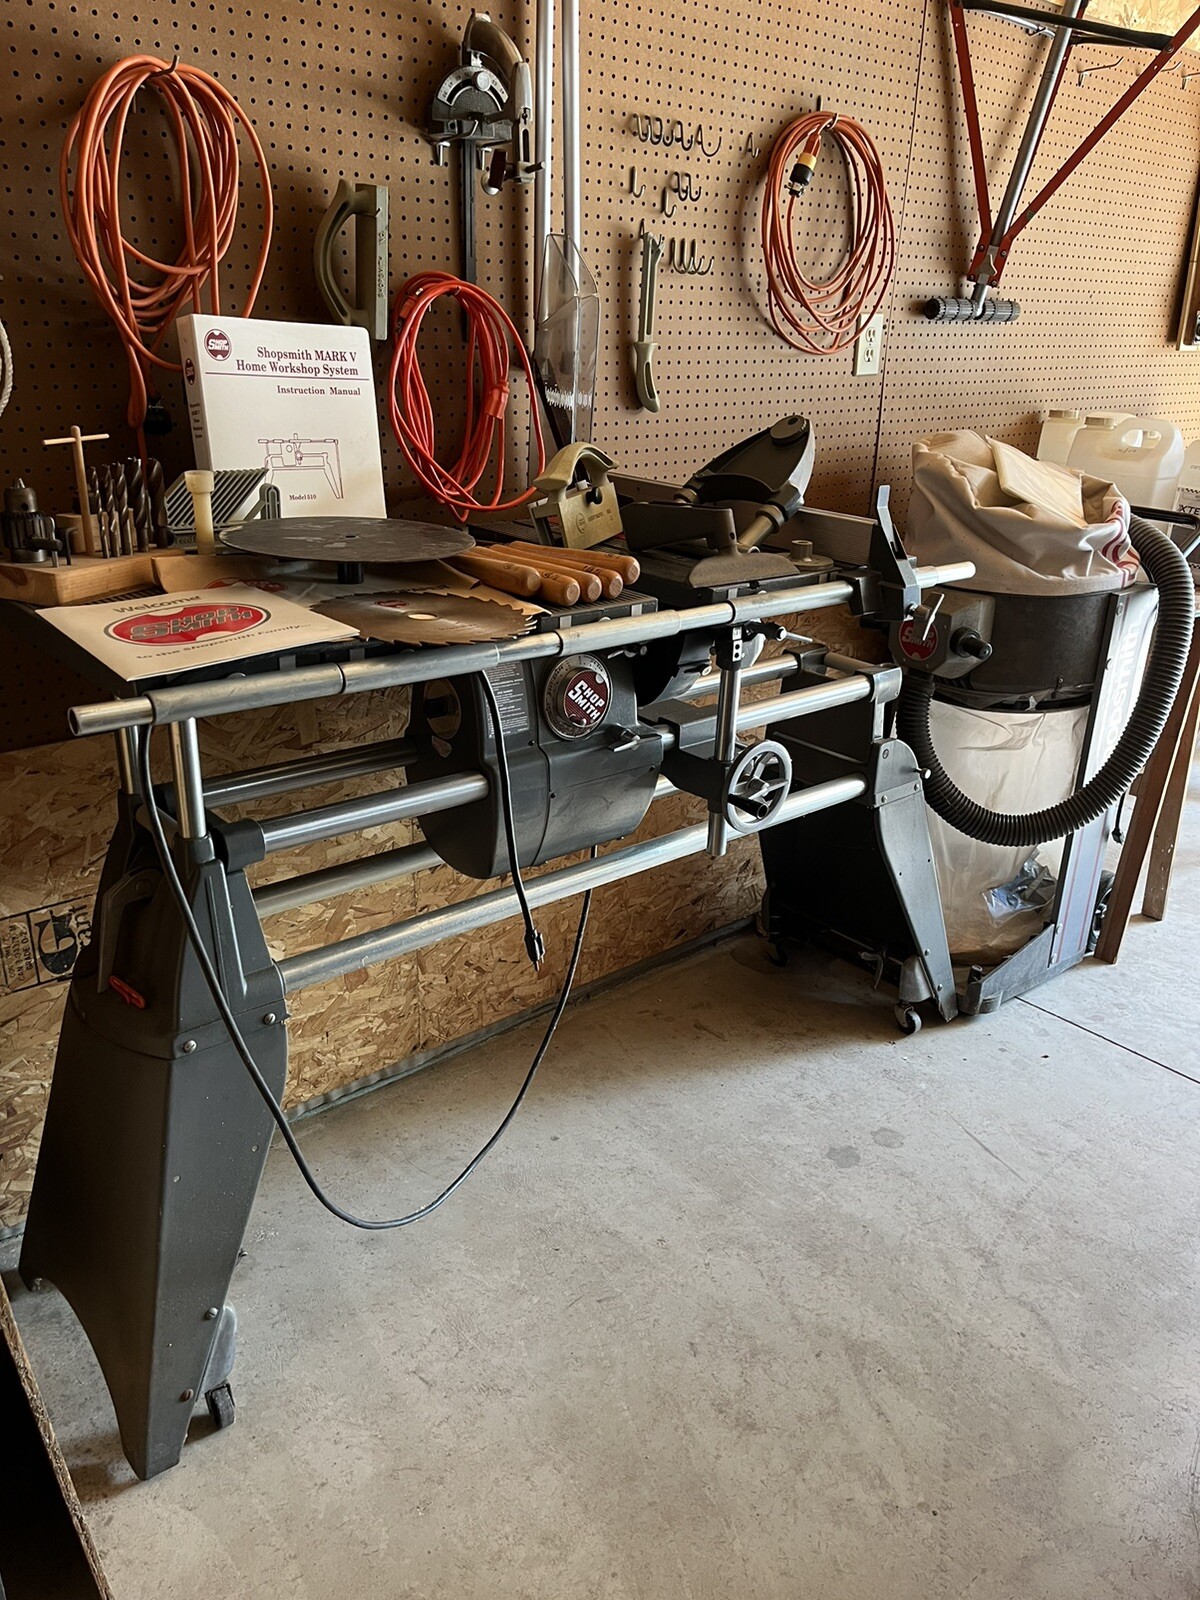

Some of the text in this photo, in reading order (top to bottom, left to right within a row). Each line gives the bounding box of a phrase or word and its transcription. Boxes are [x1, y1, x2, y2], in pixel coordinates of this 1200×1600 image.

[257, 346, 357, 362] Shopsmith MARK V
[236, 359, 359, 377] Home Workshop System
[277, 385, 361, 396] Instruction Manual
[289, 493, 306, 501] Model
[113, 595, 202, 613] Welcome
[130, 611, 254, 640] SMITH
[156, 649, 181, 659] the
[183, 634, 257, 652] Shopsmith
[569, 680, 605, 707] SHOP
[568, 687, 601, 720] SMITH
